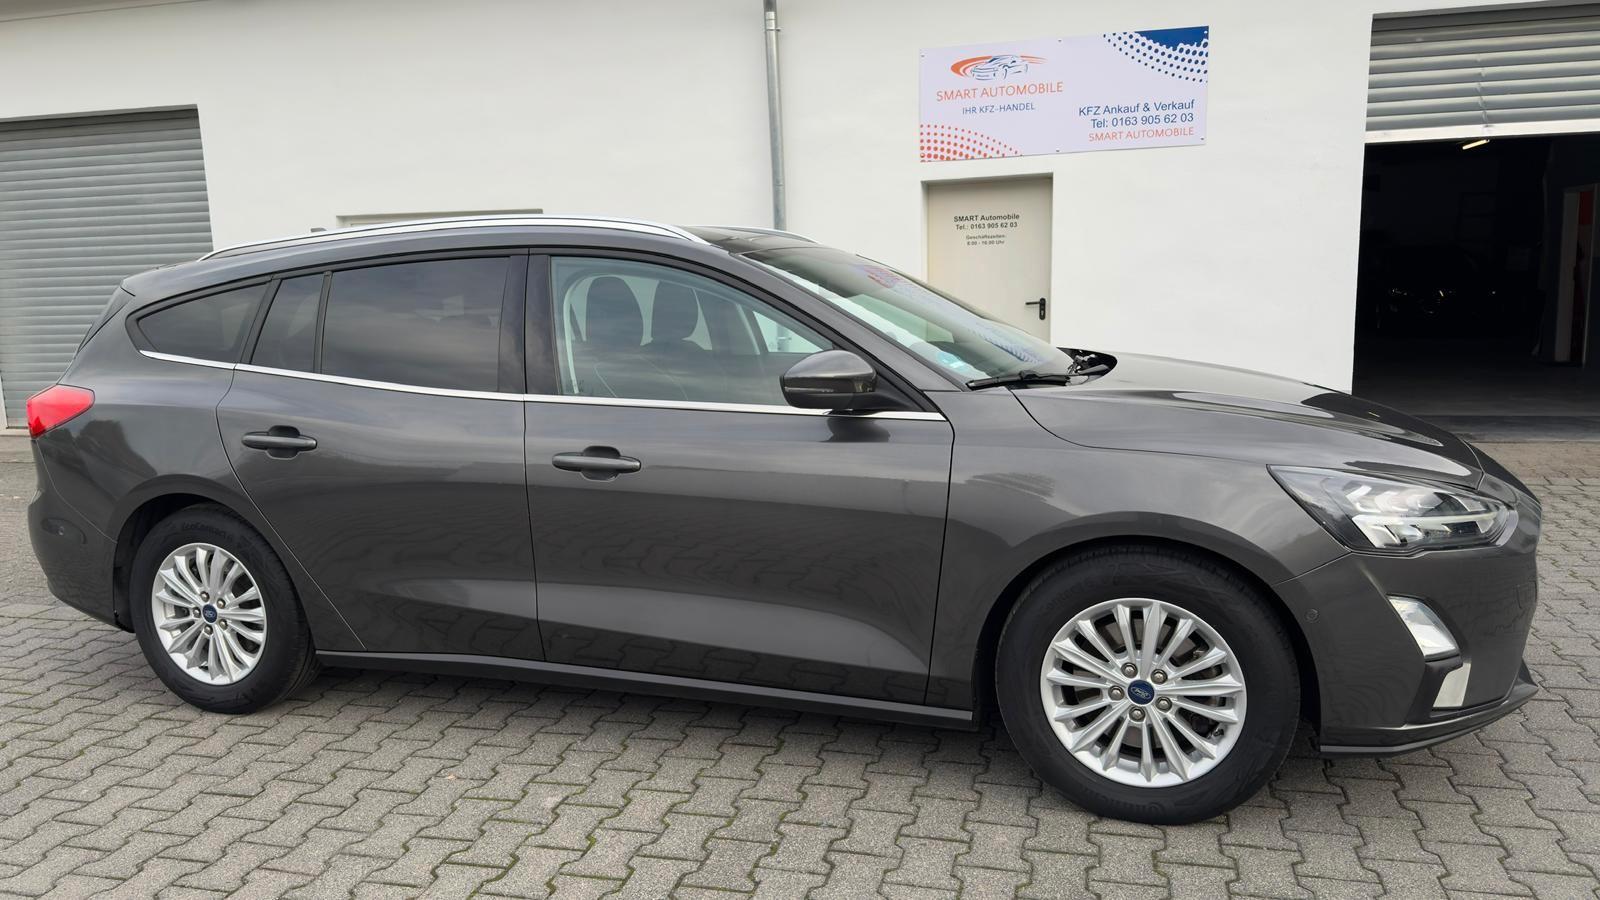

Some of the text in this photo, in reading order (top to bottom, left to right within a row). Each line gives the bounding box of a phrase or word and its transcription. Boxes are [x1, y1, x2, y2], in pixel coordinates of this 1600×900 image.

[936, 82, 1063, 102] SMART AUTOMOBILE
[962, 102, 1035, 115] IHR KFZ-HANDEL
[1079, 99, 1195, 117] KFZ Ankauf & Verkauf
[1091, 113, 1194, 129] Tel: 0163 905 62 03
[1089, 128, 1194, 142] SMART AUTOMOBILE
[980, 213, 1020, 221] Automobile
